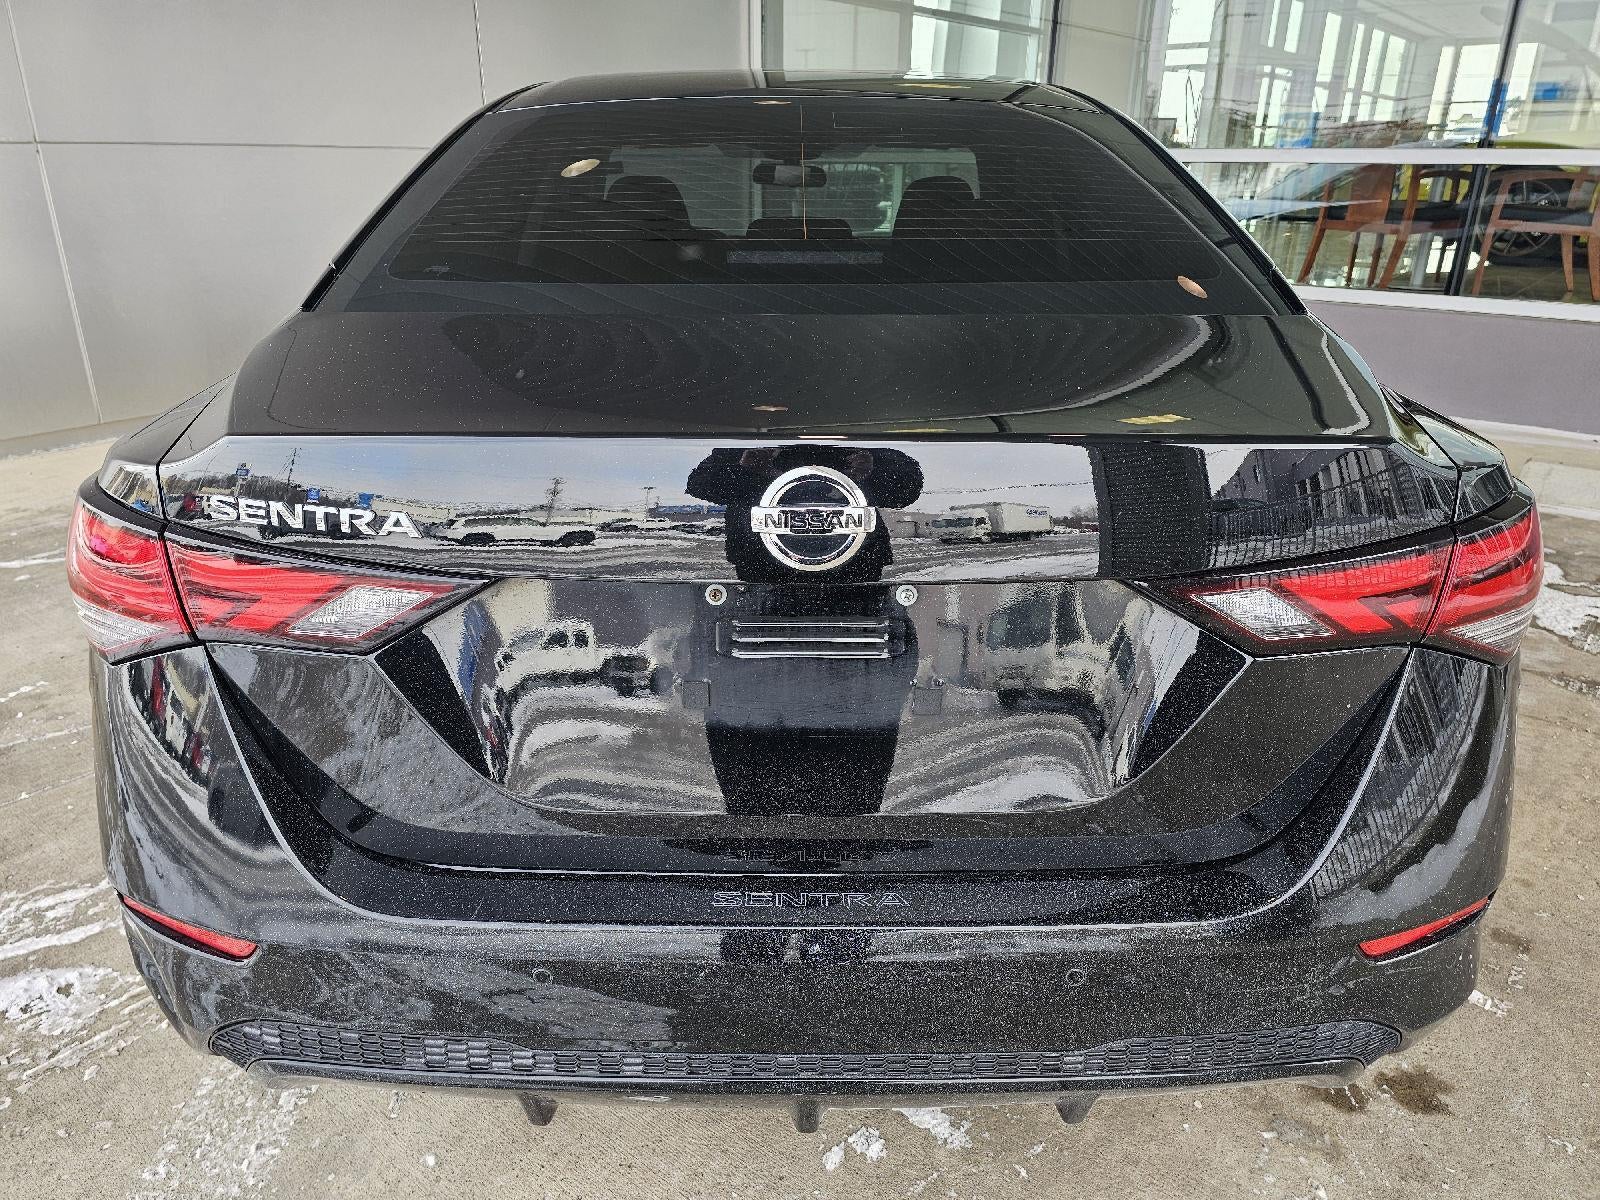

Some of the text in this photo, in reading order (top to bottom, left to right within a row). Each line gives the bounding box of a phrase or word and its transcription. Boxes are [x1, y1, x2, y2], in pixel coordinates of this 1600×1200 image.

[209, 494, 423, 538] SENTRA
[764, 512, 863, 530] NISSAN
[712, 891, 910, 908] SENTRA
